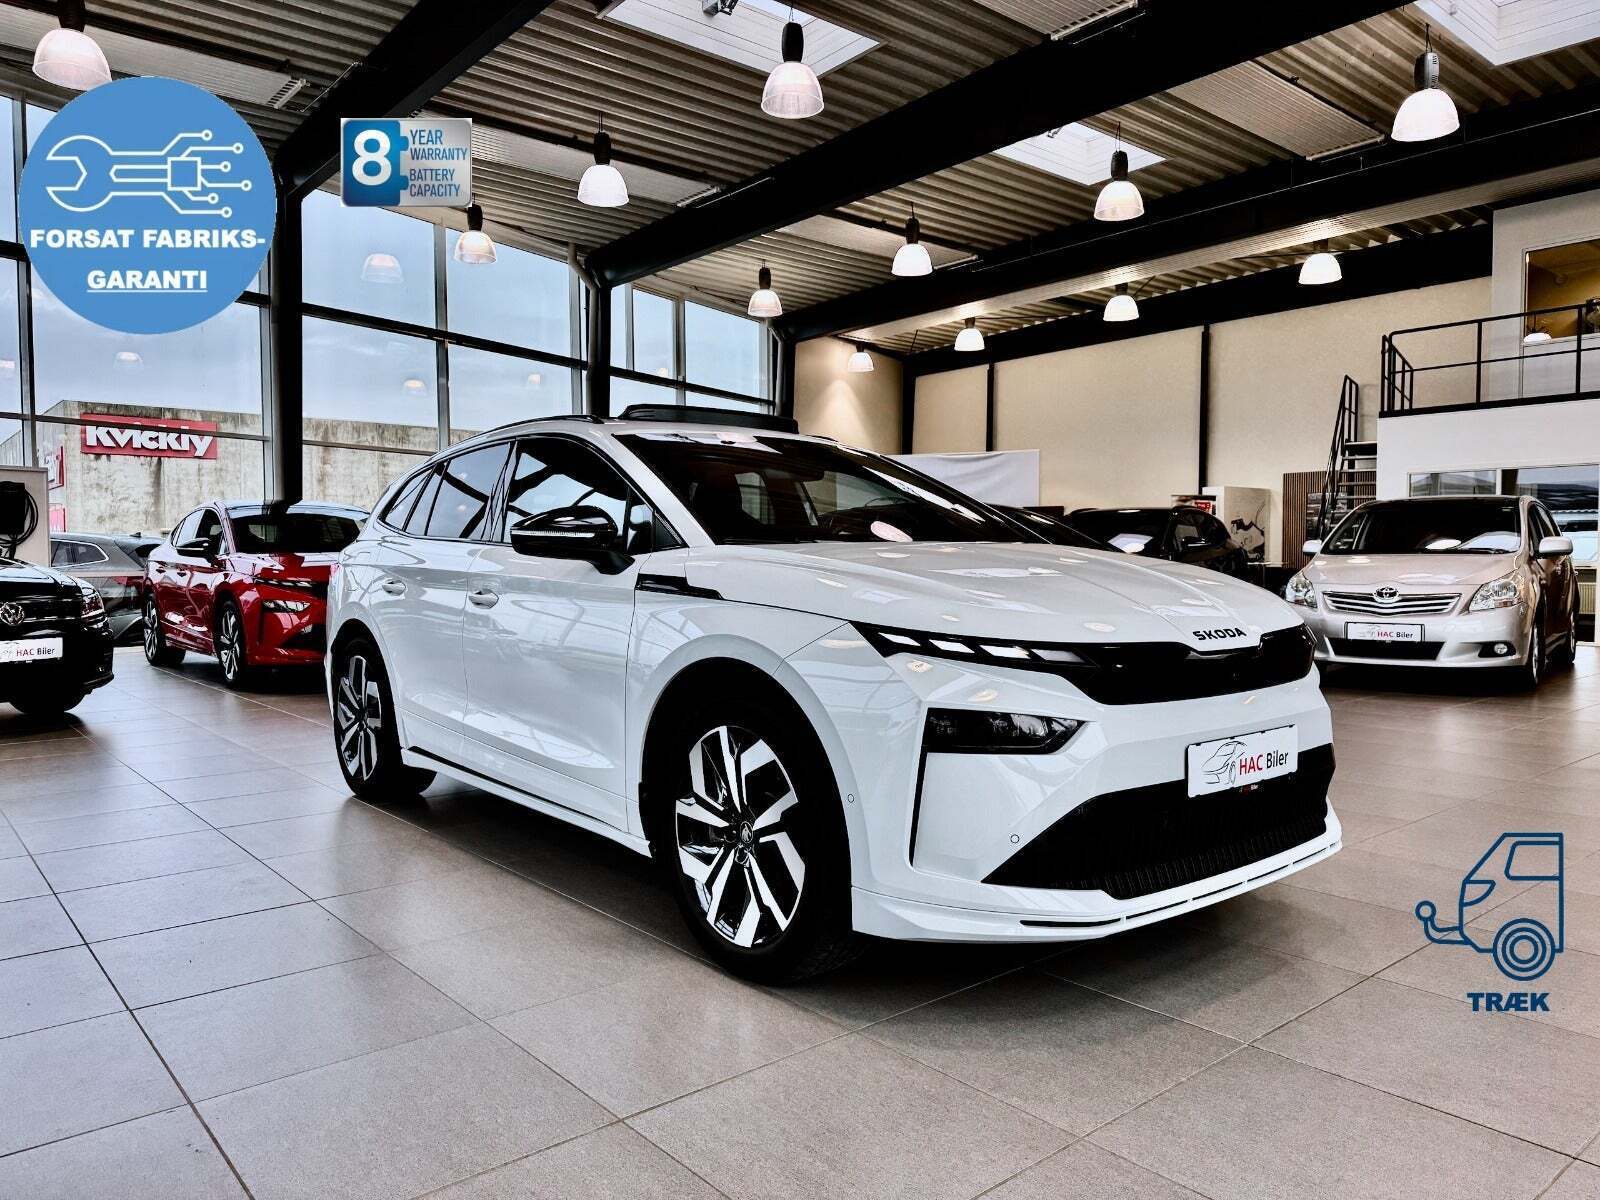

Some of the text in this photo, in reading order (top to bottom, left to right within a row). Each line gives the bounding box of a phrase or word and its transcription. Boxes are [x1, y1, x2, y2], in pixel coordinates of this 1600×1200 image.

[85, 422, 214, 457] Kvickly
[1396, 631, 1414, 639] Biler
[16, 648, 34, 656] HAC
[1239, 750, 1289, 776] HAC Biler
